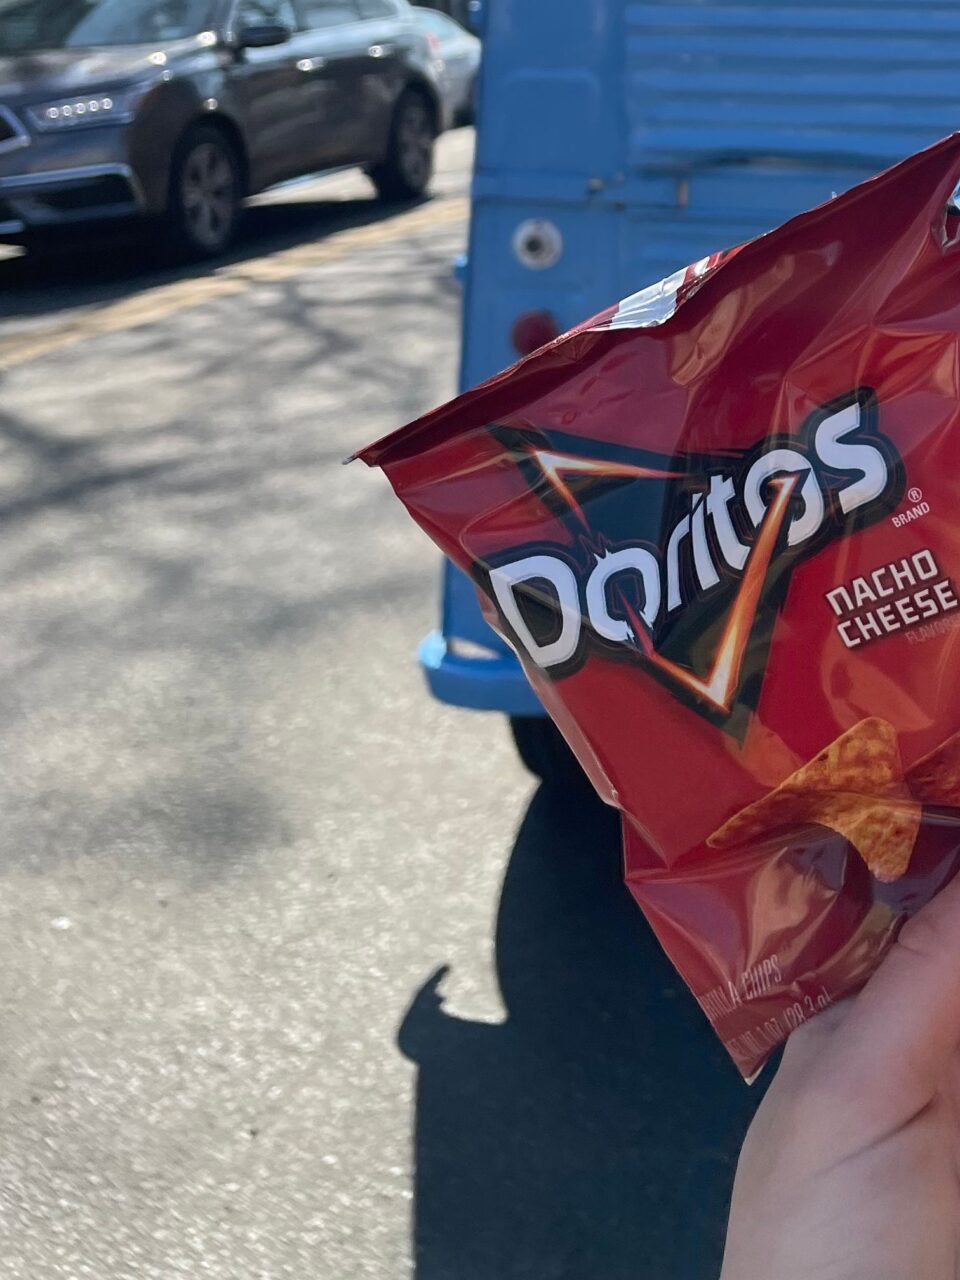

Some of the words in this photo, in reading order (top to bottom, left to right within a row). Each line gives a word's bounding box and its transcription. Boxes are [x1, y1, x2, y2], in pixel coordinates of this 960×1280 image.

[489, 401, 889, 669] Doritos
[892, 500, 930, 528] BRAND
[824, 548, 940, 616] NACHO
[836, 579, 960, 649] CHEESE
[741, 954, 782, 1000] CHIPS
